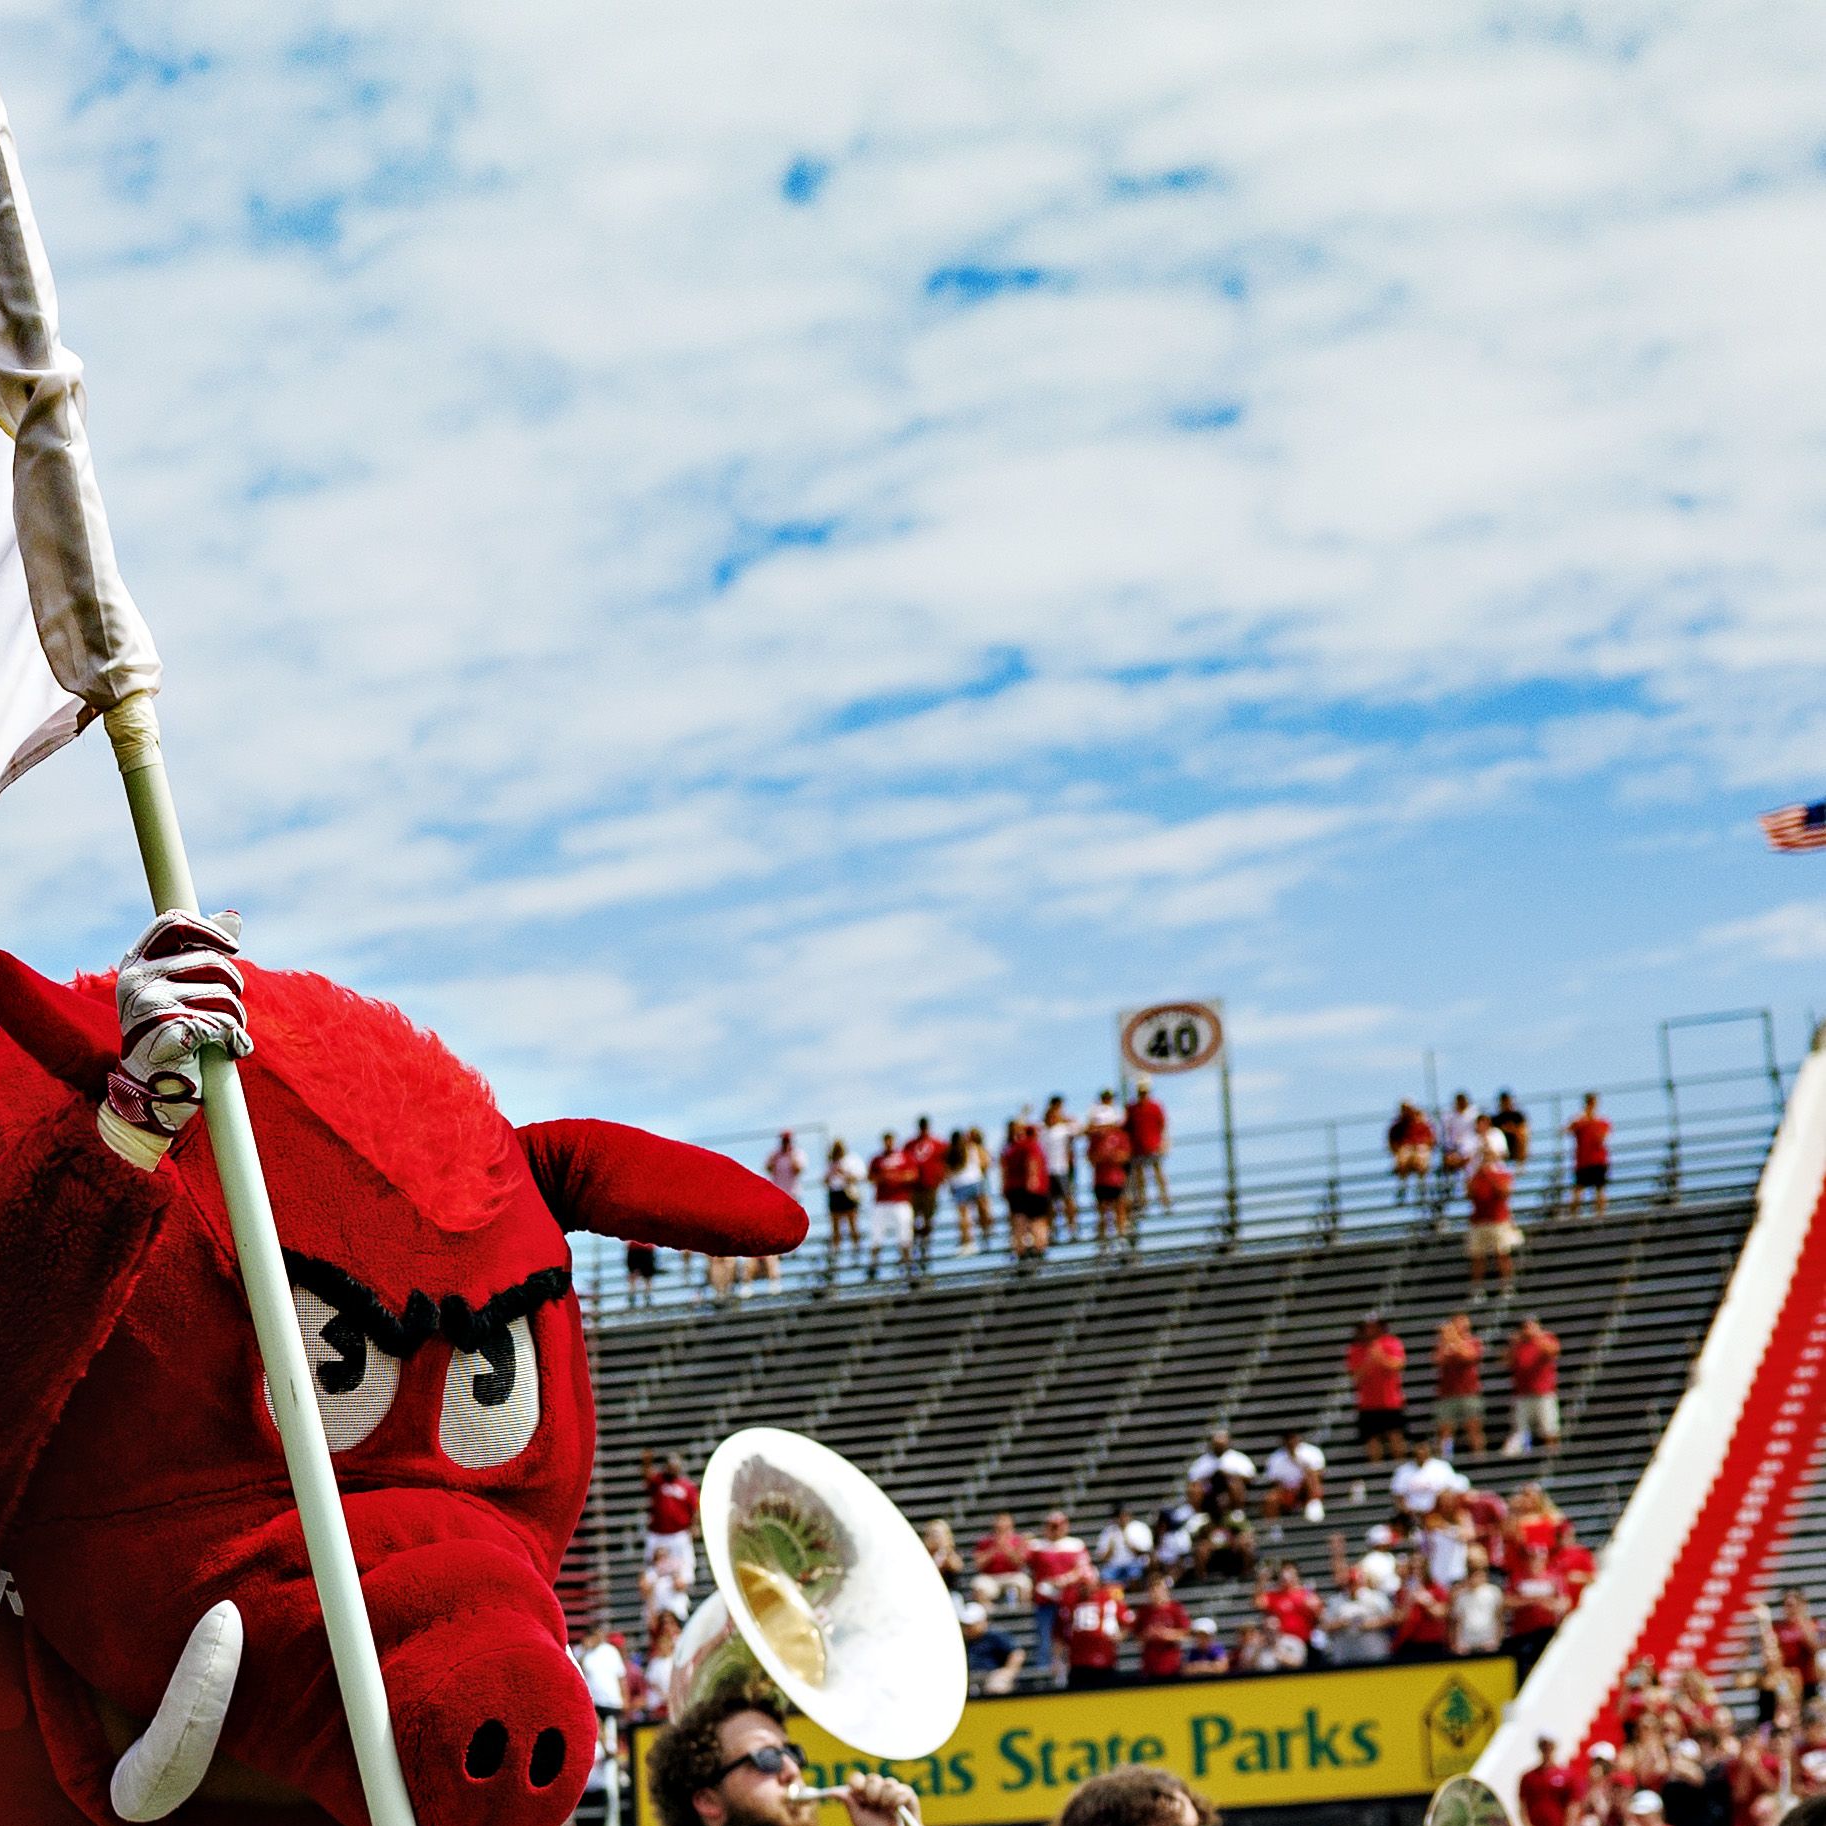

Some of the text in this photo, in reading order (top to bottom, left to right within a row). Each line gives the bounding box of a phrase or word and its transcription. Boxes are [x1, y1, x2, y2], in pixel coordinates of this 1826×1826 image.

[1146, 1025, 1199, 1058] 40
[801, 1706, 1382, 1801] ansas State Parks
